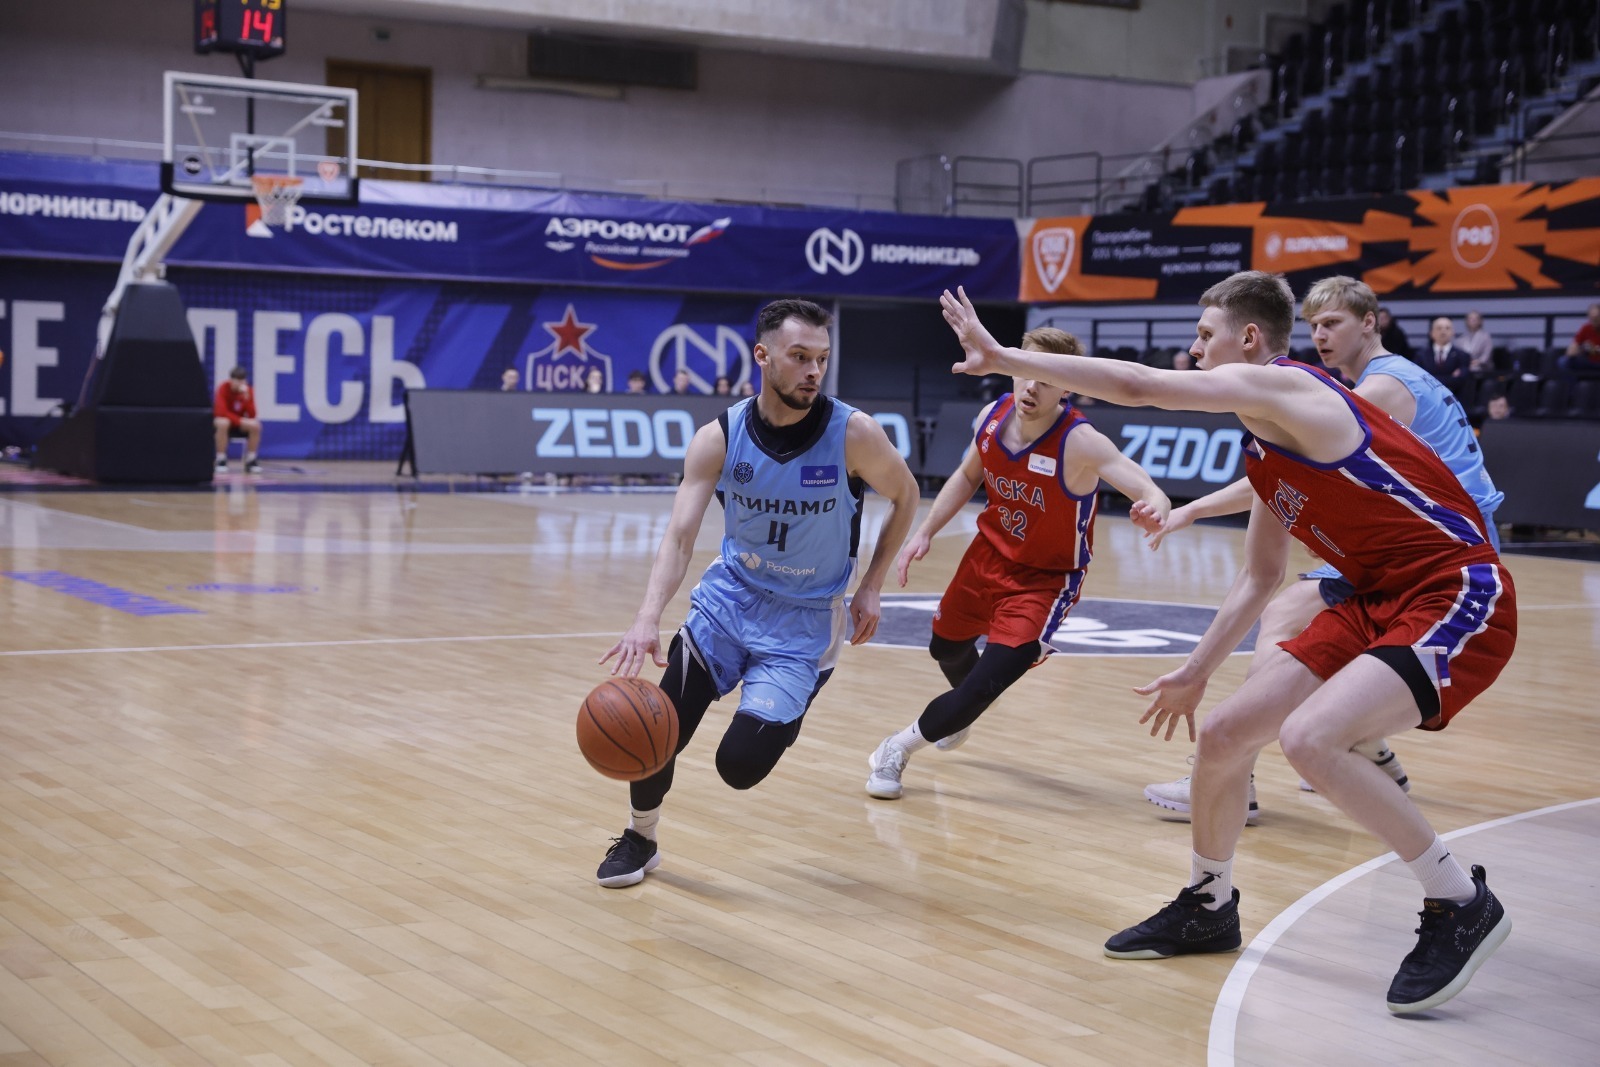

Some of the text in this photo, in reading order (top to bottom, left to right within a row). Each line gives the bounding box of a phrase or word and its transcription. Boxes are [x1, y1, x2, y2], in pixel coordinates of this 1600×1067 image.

[242, 9, 274, 43] 14
[284, 204, 458, 242] Ростелеком
[544, 217, 692, 243] АЭРОФЛОТ
[871, 243, 981, 267] НОРНИКЕЛЬ
[535, 364, 594, 391] ЦСК
[531, 407, 696, 460] ZEDO
[1120, 424, 1244, 483] ZEDO
[732, 491, 837, 516] ДИНАМО
[766, 520, 789, 552] 4
[998, 506, 1028, 541] 32
